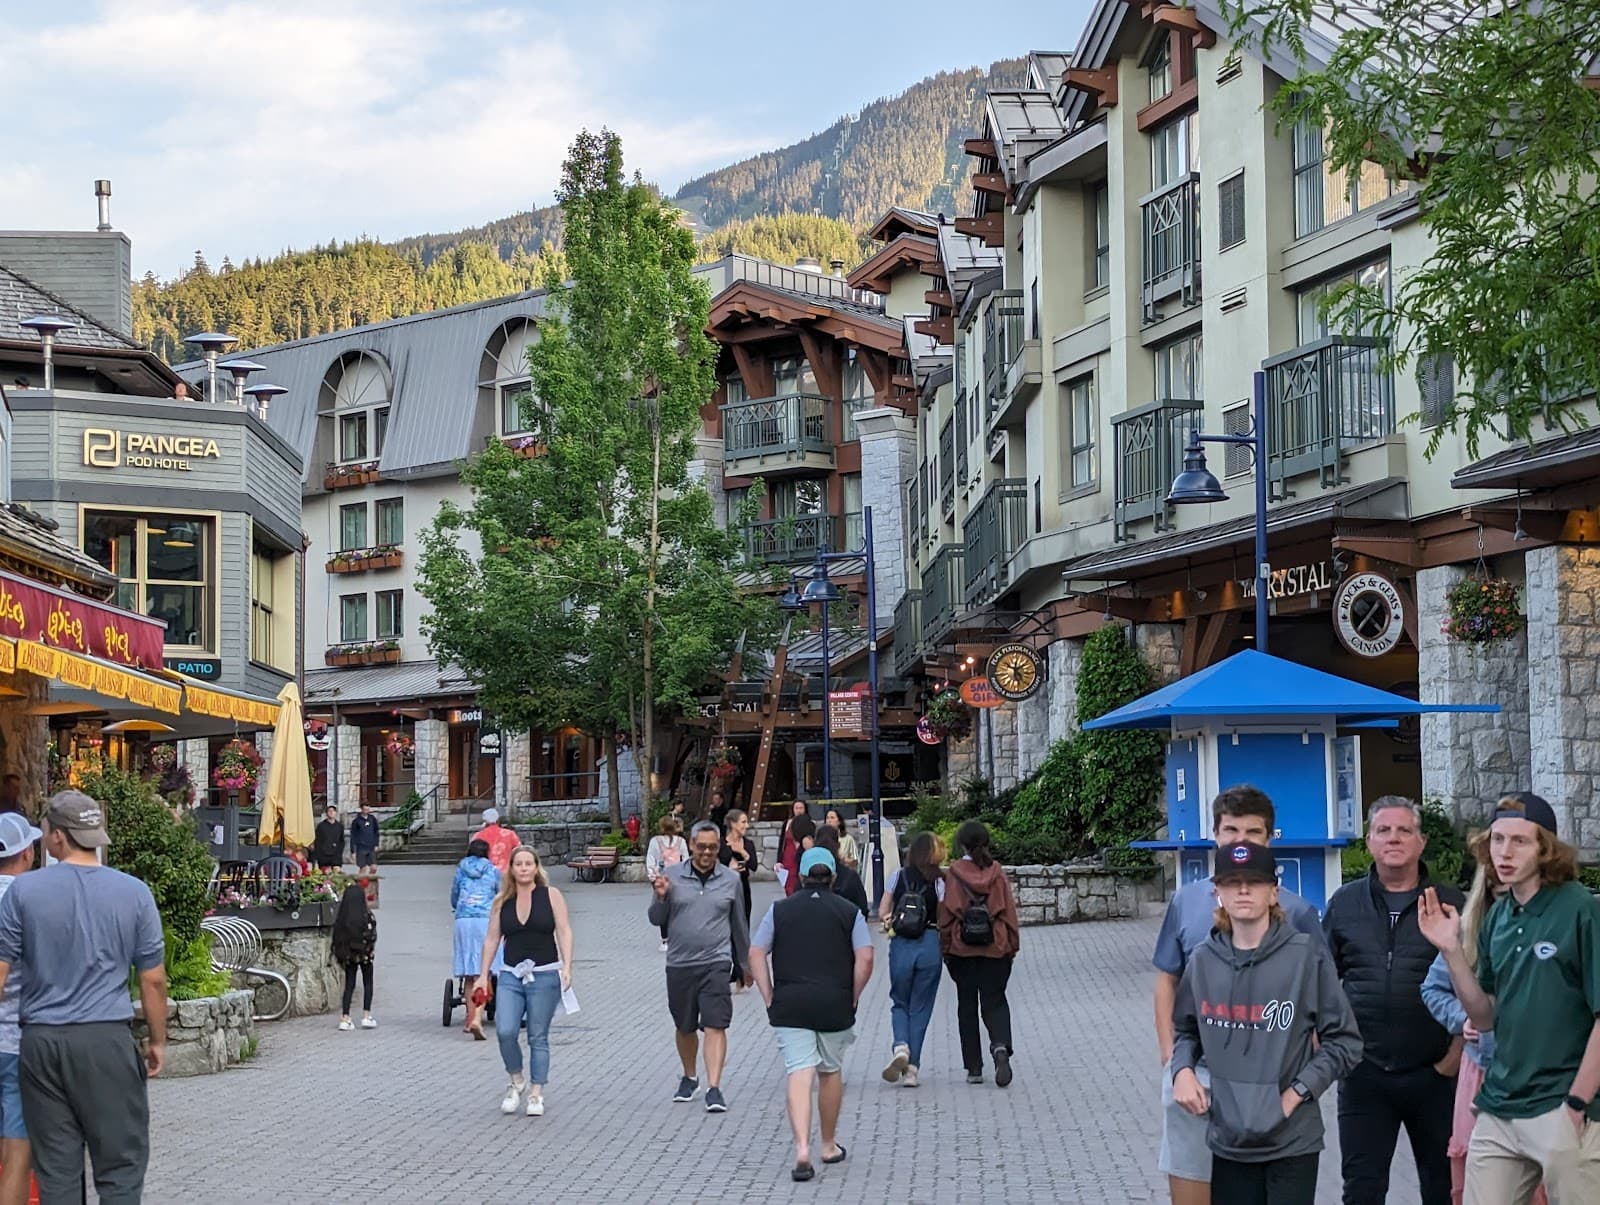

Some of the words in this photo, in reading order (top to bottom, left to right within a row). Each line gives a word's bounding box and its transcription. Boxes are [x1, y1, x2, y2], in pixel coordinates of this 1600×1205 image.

[127, 434, 220, 458] PANGEA
[126, 456, 152, 467] POD
[154, 458, 193, 471] HOTEL
[1254, 561, 1332, 600] RYSTAL
[1341, 578, 1367, 609] ROCKS
[1367, 578, 1377, 587] &
[1379, 581, 1400, 610] GEMS
[1350, 636, 1393, 653] CANADA
[178, 662, 214, 674] PATIO
[454, 710, 482, 721] Roots
[1262, 999, 1295, 1032] 90
